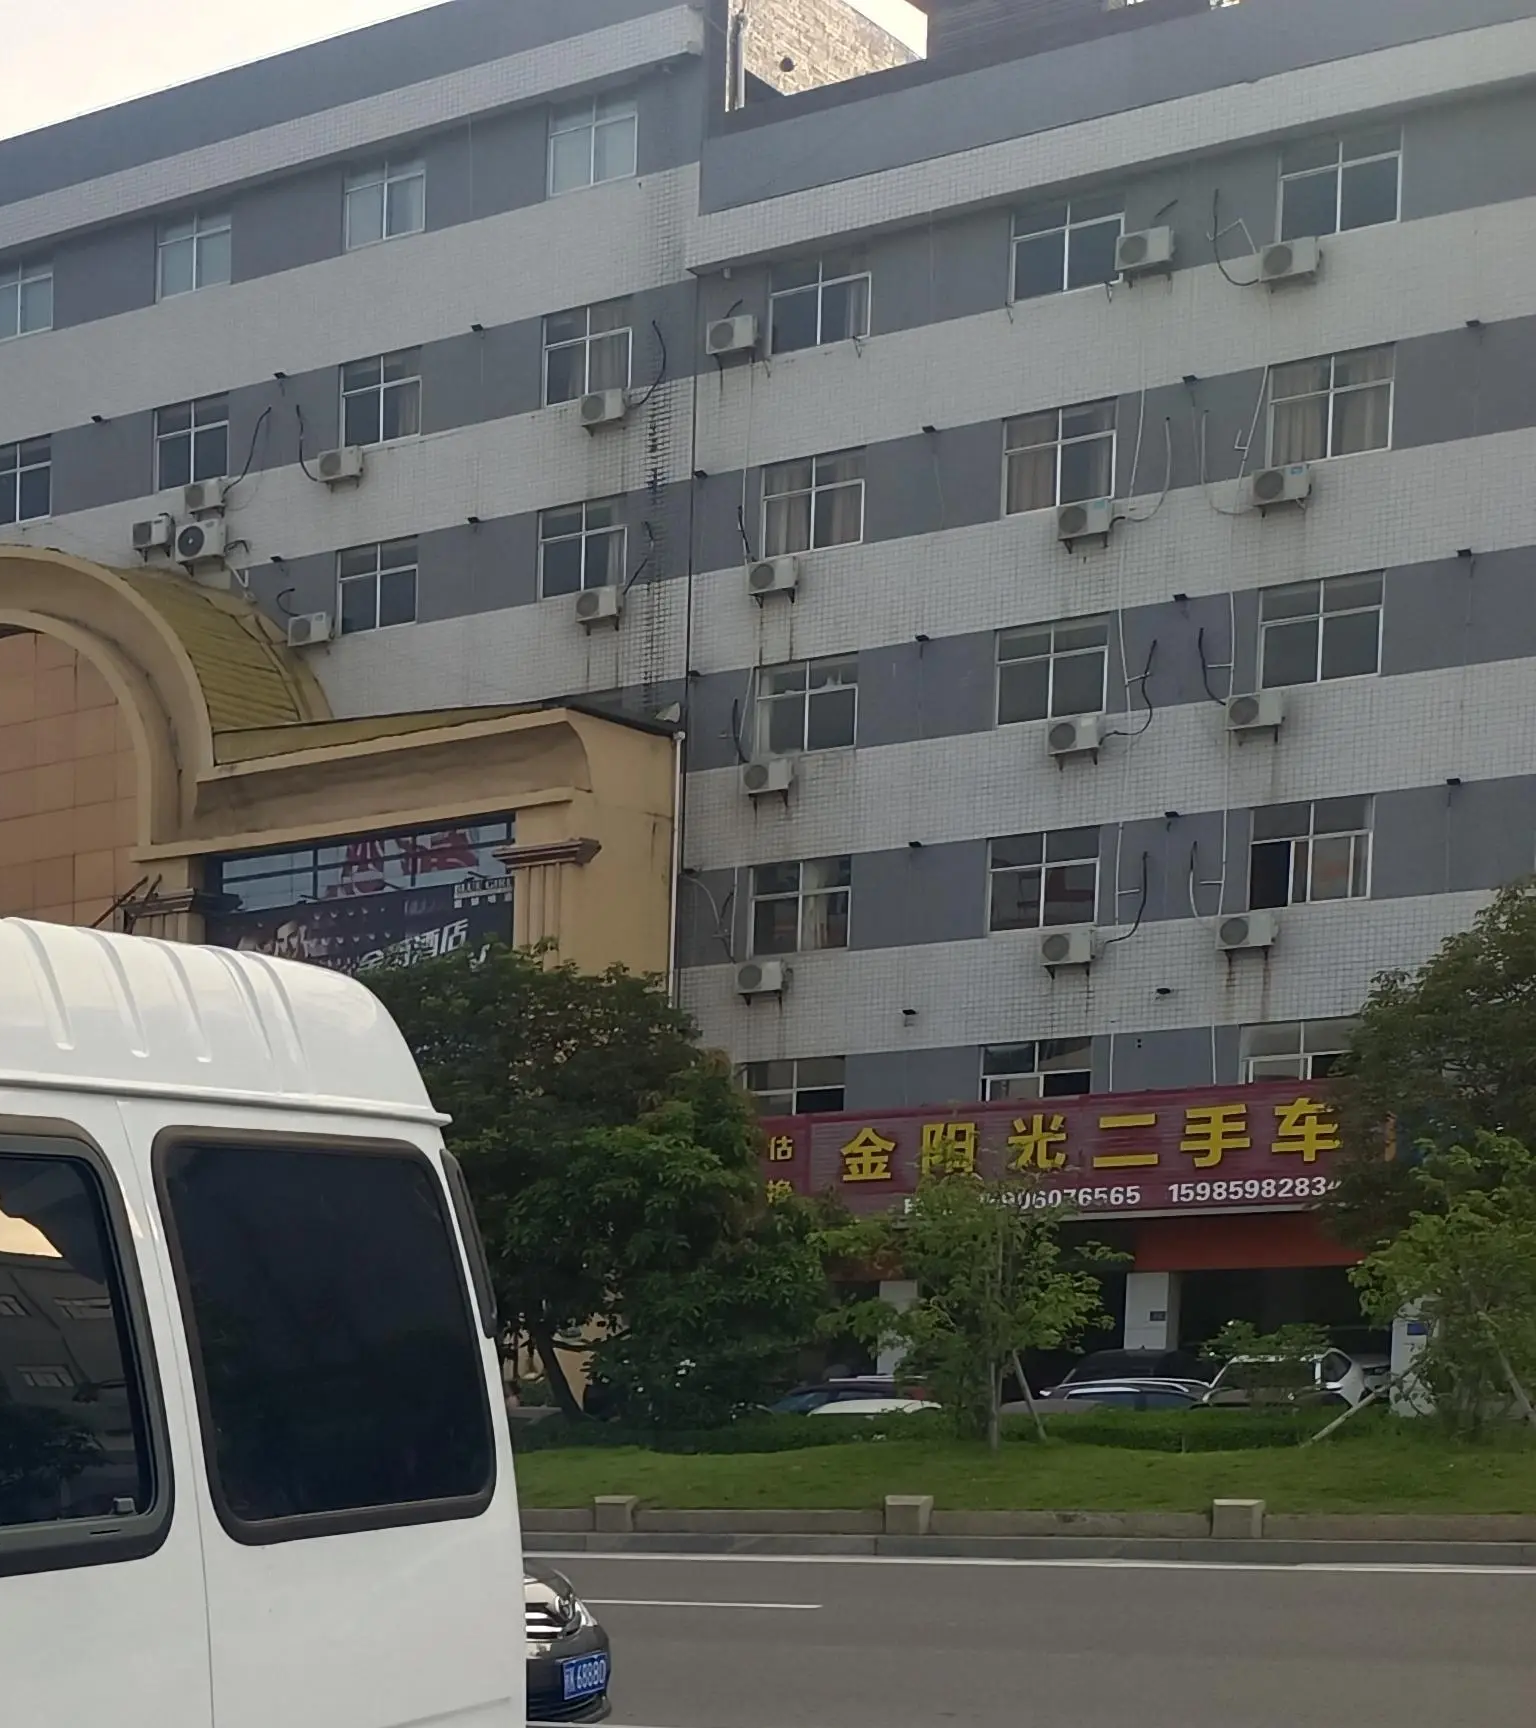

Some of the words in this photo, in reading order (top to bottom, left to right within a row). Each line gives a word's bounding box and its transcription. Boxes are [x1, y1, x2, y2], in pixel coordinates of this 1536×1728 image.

[839, 1096, 1343, 1184] 金阳光二手车
